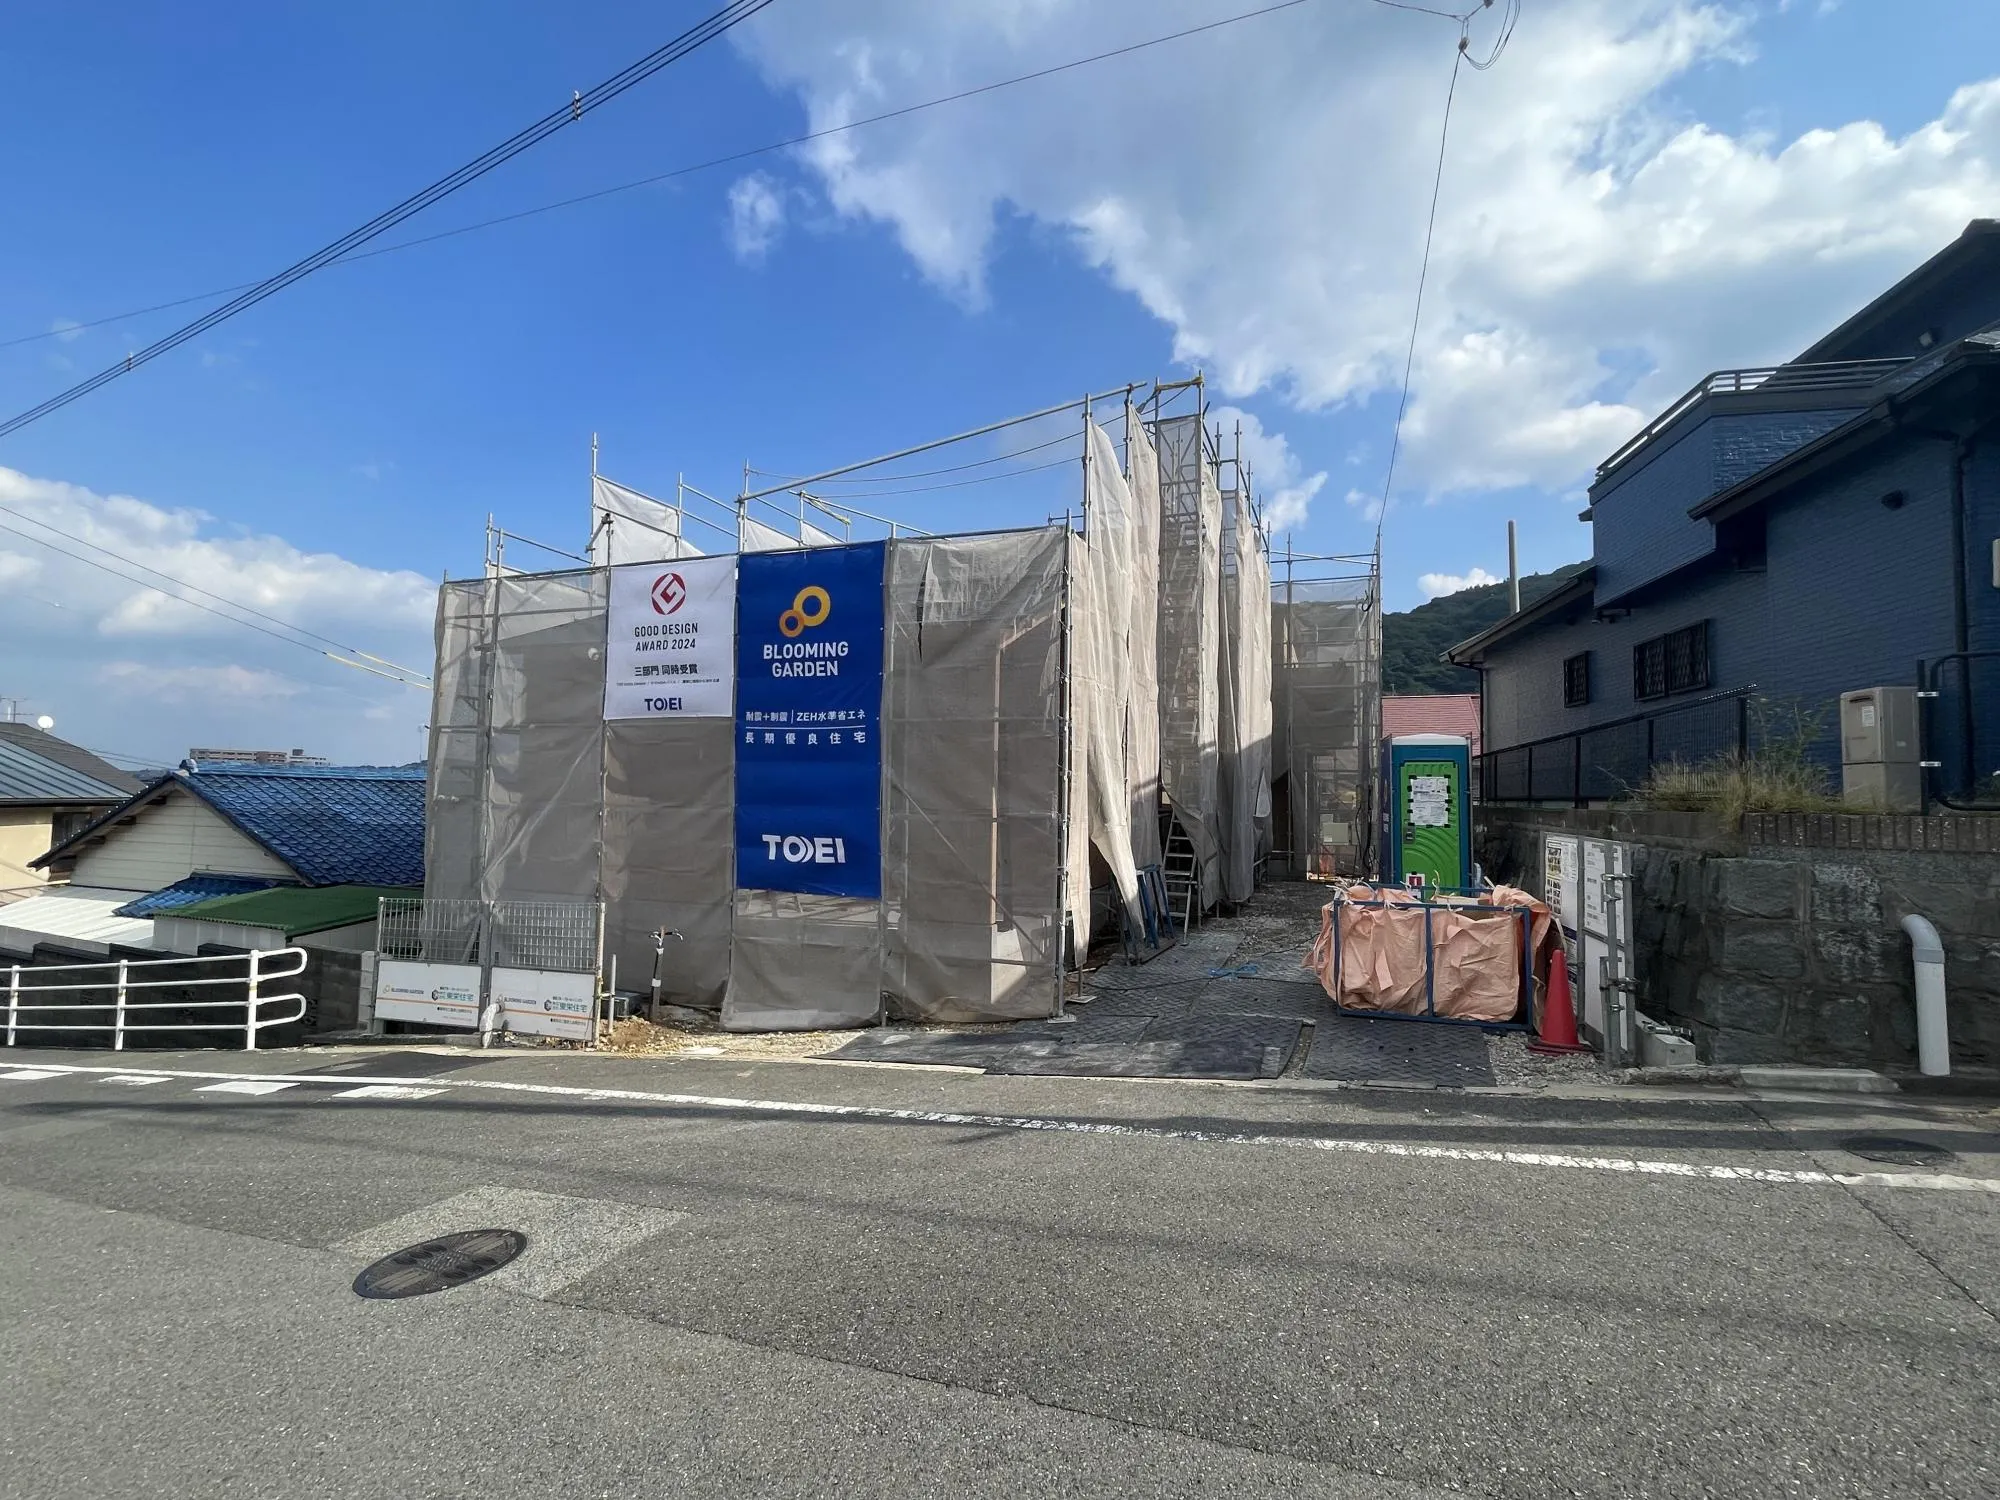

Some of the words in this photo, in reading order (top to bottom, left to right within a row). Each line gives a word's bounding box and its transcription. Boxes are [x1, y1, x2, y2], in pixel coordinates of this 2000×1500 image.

[634, 625, 659, 638] GOOD
[662, 622, 698, 635] DESIGN
[635, 640, 669, 652] AWARD
[671, 638, 696, 650] 2024
[763, 641, 849, 660] BLOOMING
[634, 665, 660, 677] 三部門
[661, 663, 698, 675] 同時受賞
[772, 660, 838, 678] GARDEN
[796, 709, 866, 722] ZEH水準省エネ
